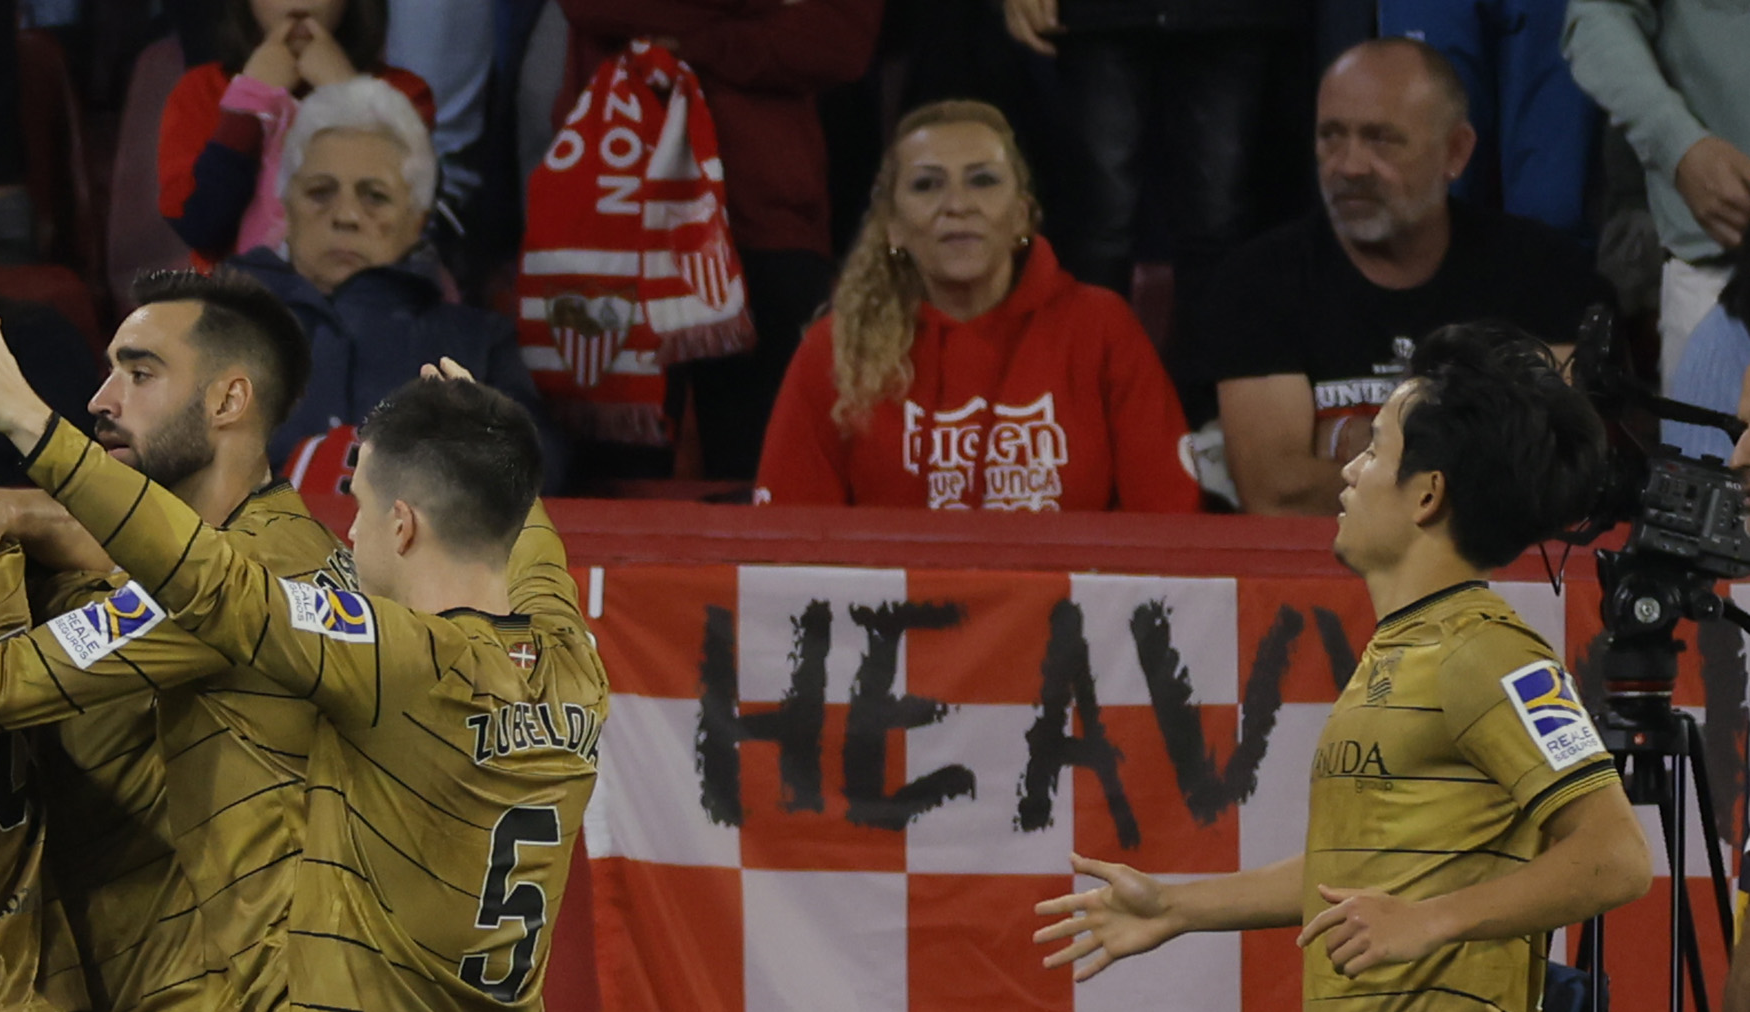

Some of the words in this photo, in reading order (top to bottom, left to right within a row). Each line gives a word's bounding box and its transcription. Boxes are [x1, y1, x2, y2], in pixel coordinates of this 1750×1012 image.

[54, 618, 89, 660] SEGUROS
[68, 612, 101, 654] REALE
[465, 701, 601, 772] ZUBELDIA
[1545, 725, 1593, 753] REALE
[457, 805, 561, 1003] 5
